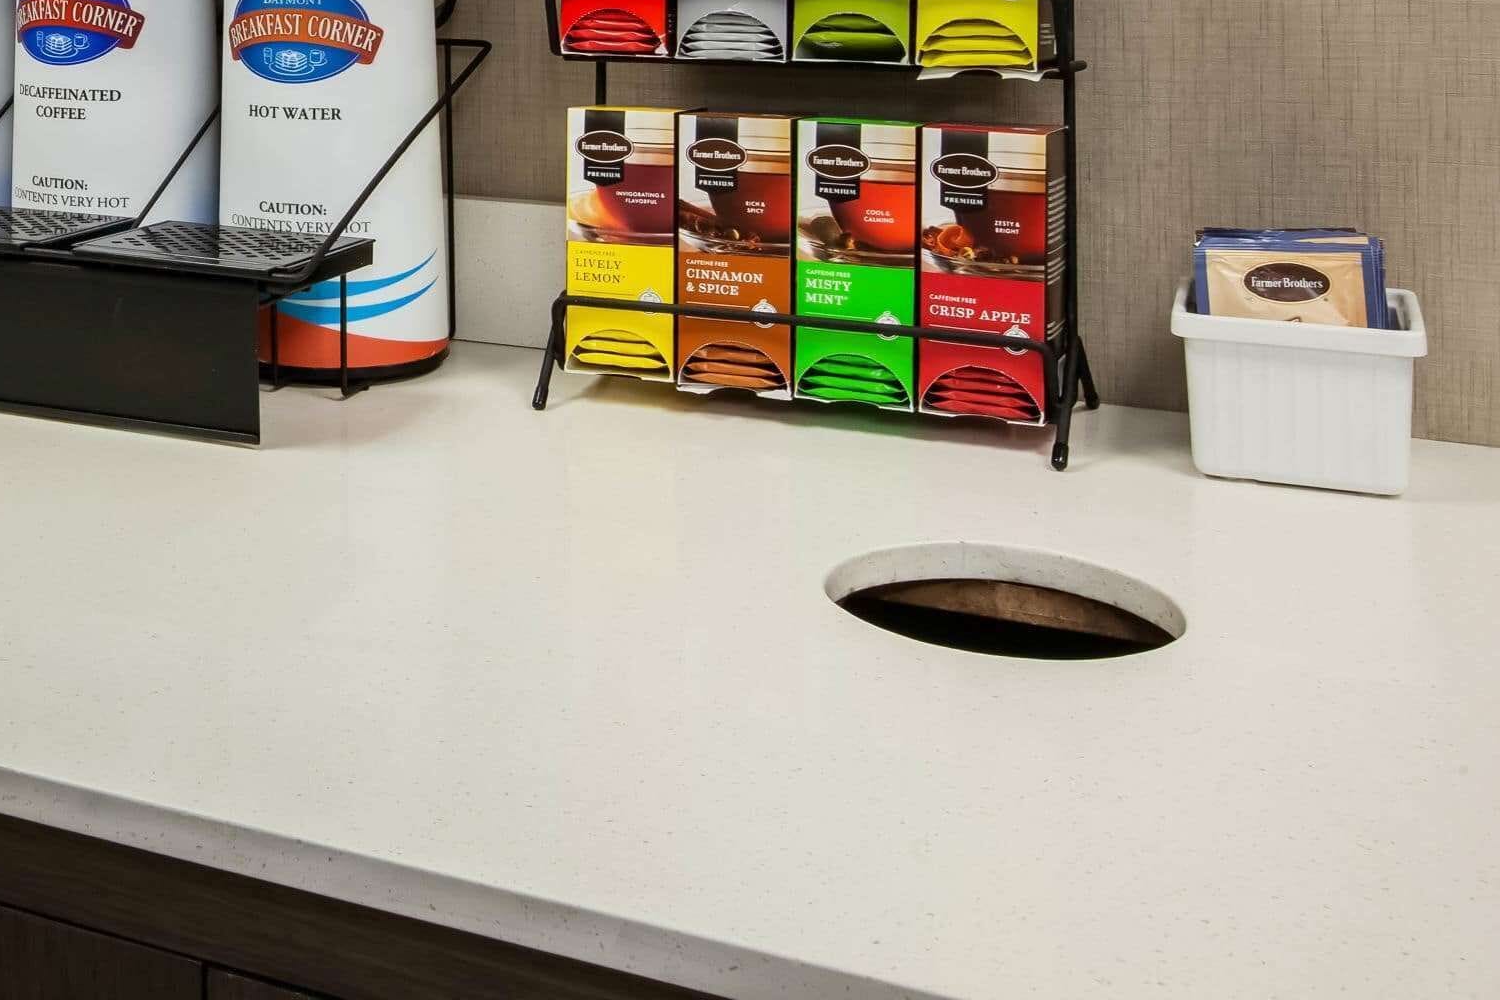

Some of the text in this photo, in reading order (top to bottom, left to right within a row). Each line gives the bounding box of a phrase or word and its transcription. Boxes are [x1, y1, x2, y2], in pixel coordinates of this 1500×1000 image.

[72, 1, 138, 37] CORNER
[230, 13, 377, 53] BREAKFAST CORNER
[19, 83, 122, 102] DECAFFEINATED
[36, 105, 86, 120] COFFEE
[249, 104, 342, 121] HOT WATER
[937, 164, 992, 177] Farmer Brothers
[32, 175, 88, 191] CAUTION:
[819, 187, 857, 195] PREMIUM
[61, 195, 94, 208] VERY
[97, 197, 130, 208] HOT
[259, 200, 327, 216] CAUTION:
[944, 197, 983, 205] PREMIUM
[232, 213, 371, 234] CONTENTS VERY OT
[575, 257, 622, 270] LIVELY
[686, 259, 714, 267] CAFFEINE
[575, 271, 621, 284] LEMON
[686, 268, 763, 284] CINNAMON
[1251, 276, 1324, 289] Farmer Brothers
[686, 282, 739, 296] & SPICE
[805, 277, 852, 292] MISTY
[805, 292, 843, 306] MINT
[929, 304, 1031, 324] CRISP APPLE
